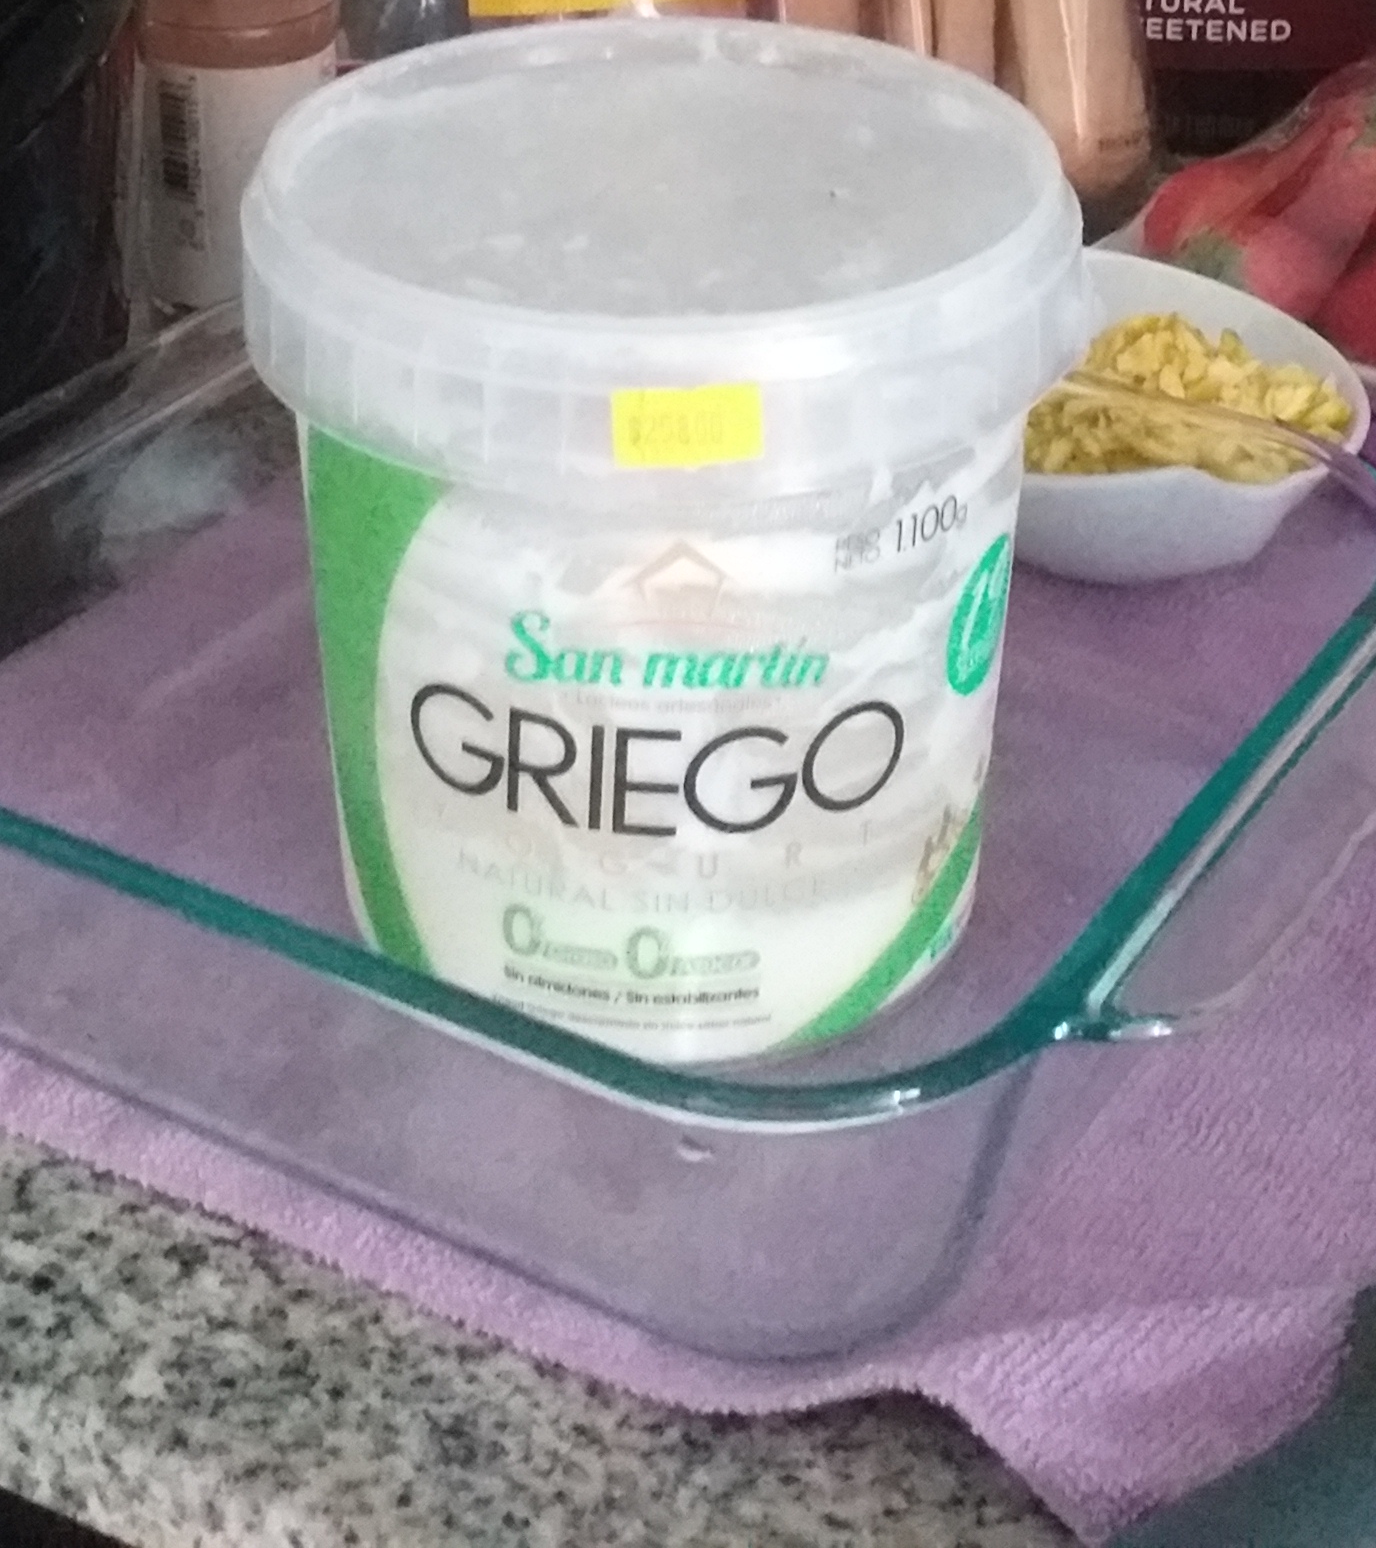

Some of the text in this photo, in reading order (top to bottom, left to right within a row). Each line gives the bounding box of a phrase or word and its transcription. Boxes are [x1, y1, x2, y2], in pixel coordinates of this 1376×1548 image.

[1142, 17, 1292, 43] EETENED
[503, 608, 623, 688] San
[409, 681, 906, 837] GRIEGO
